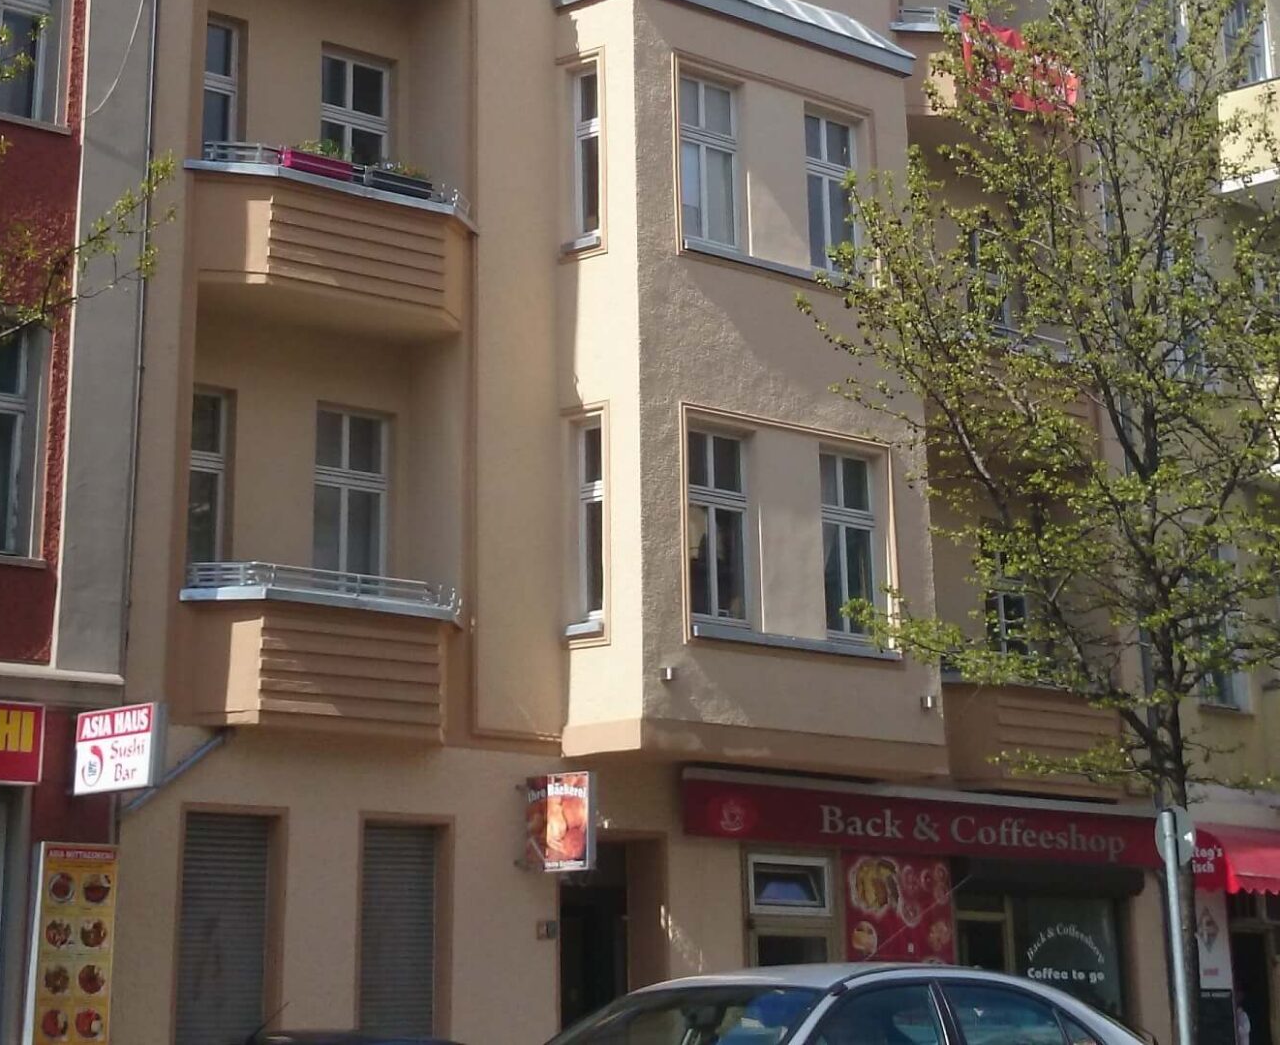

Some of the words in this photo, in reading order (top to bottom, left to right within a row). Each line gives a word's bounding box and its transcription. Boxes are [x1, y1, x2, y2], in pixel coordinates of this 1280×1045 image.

[81, 714, 113, 741] ASIA
[113, 707, 149, 734] HAUS
[109, 737, 146, 760] Sushi
[114, 762, 138, 783] Bar
[819, 804, 904, 840] Back
[913, 812, 940, 843] &
[949, 814, 1126, 862] Coffeeshop
[1027, 967, 1069, 980] Coffee
[1072, 969, 1086, 980] to
[1089, 971, 1105, 984] go
